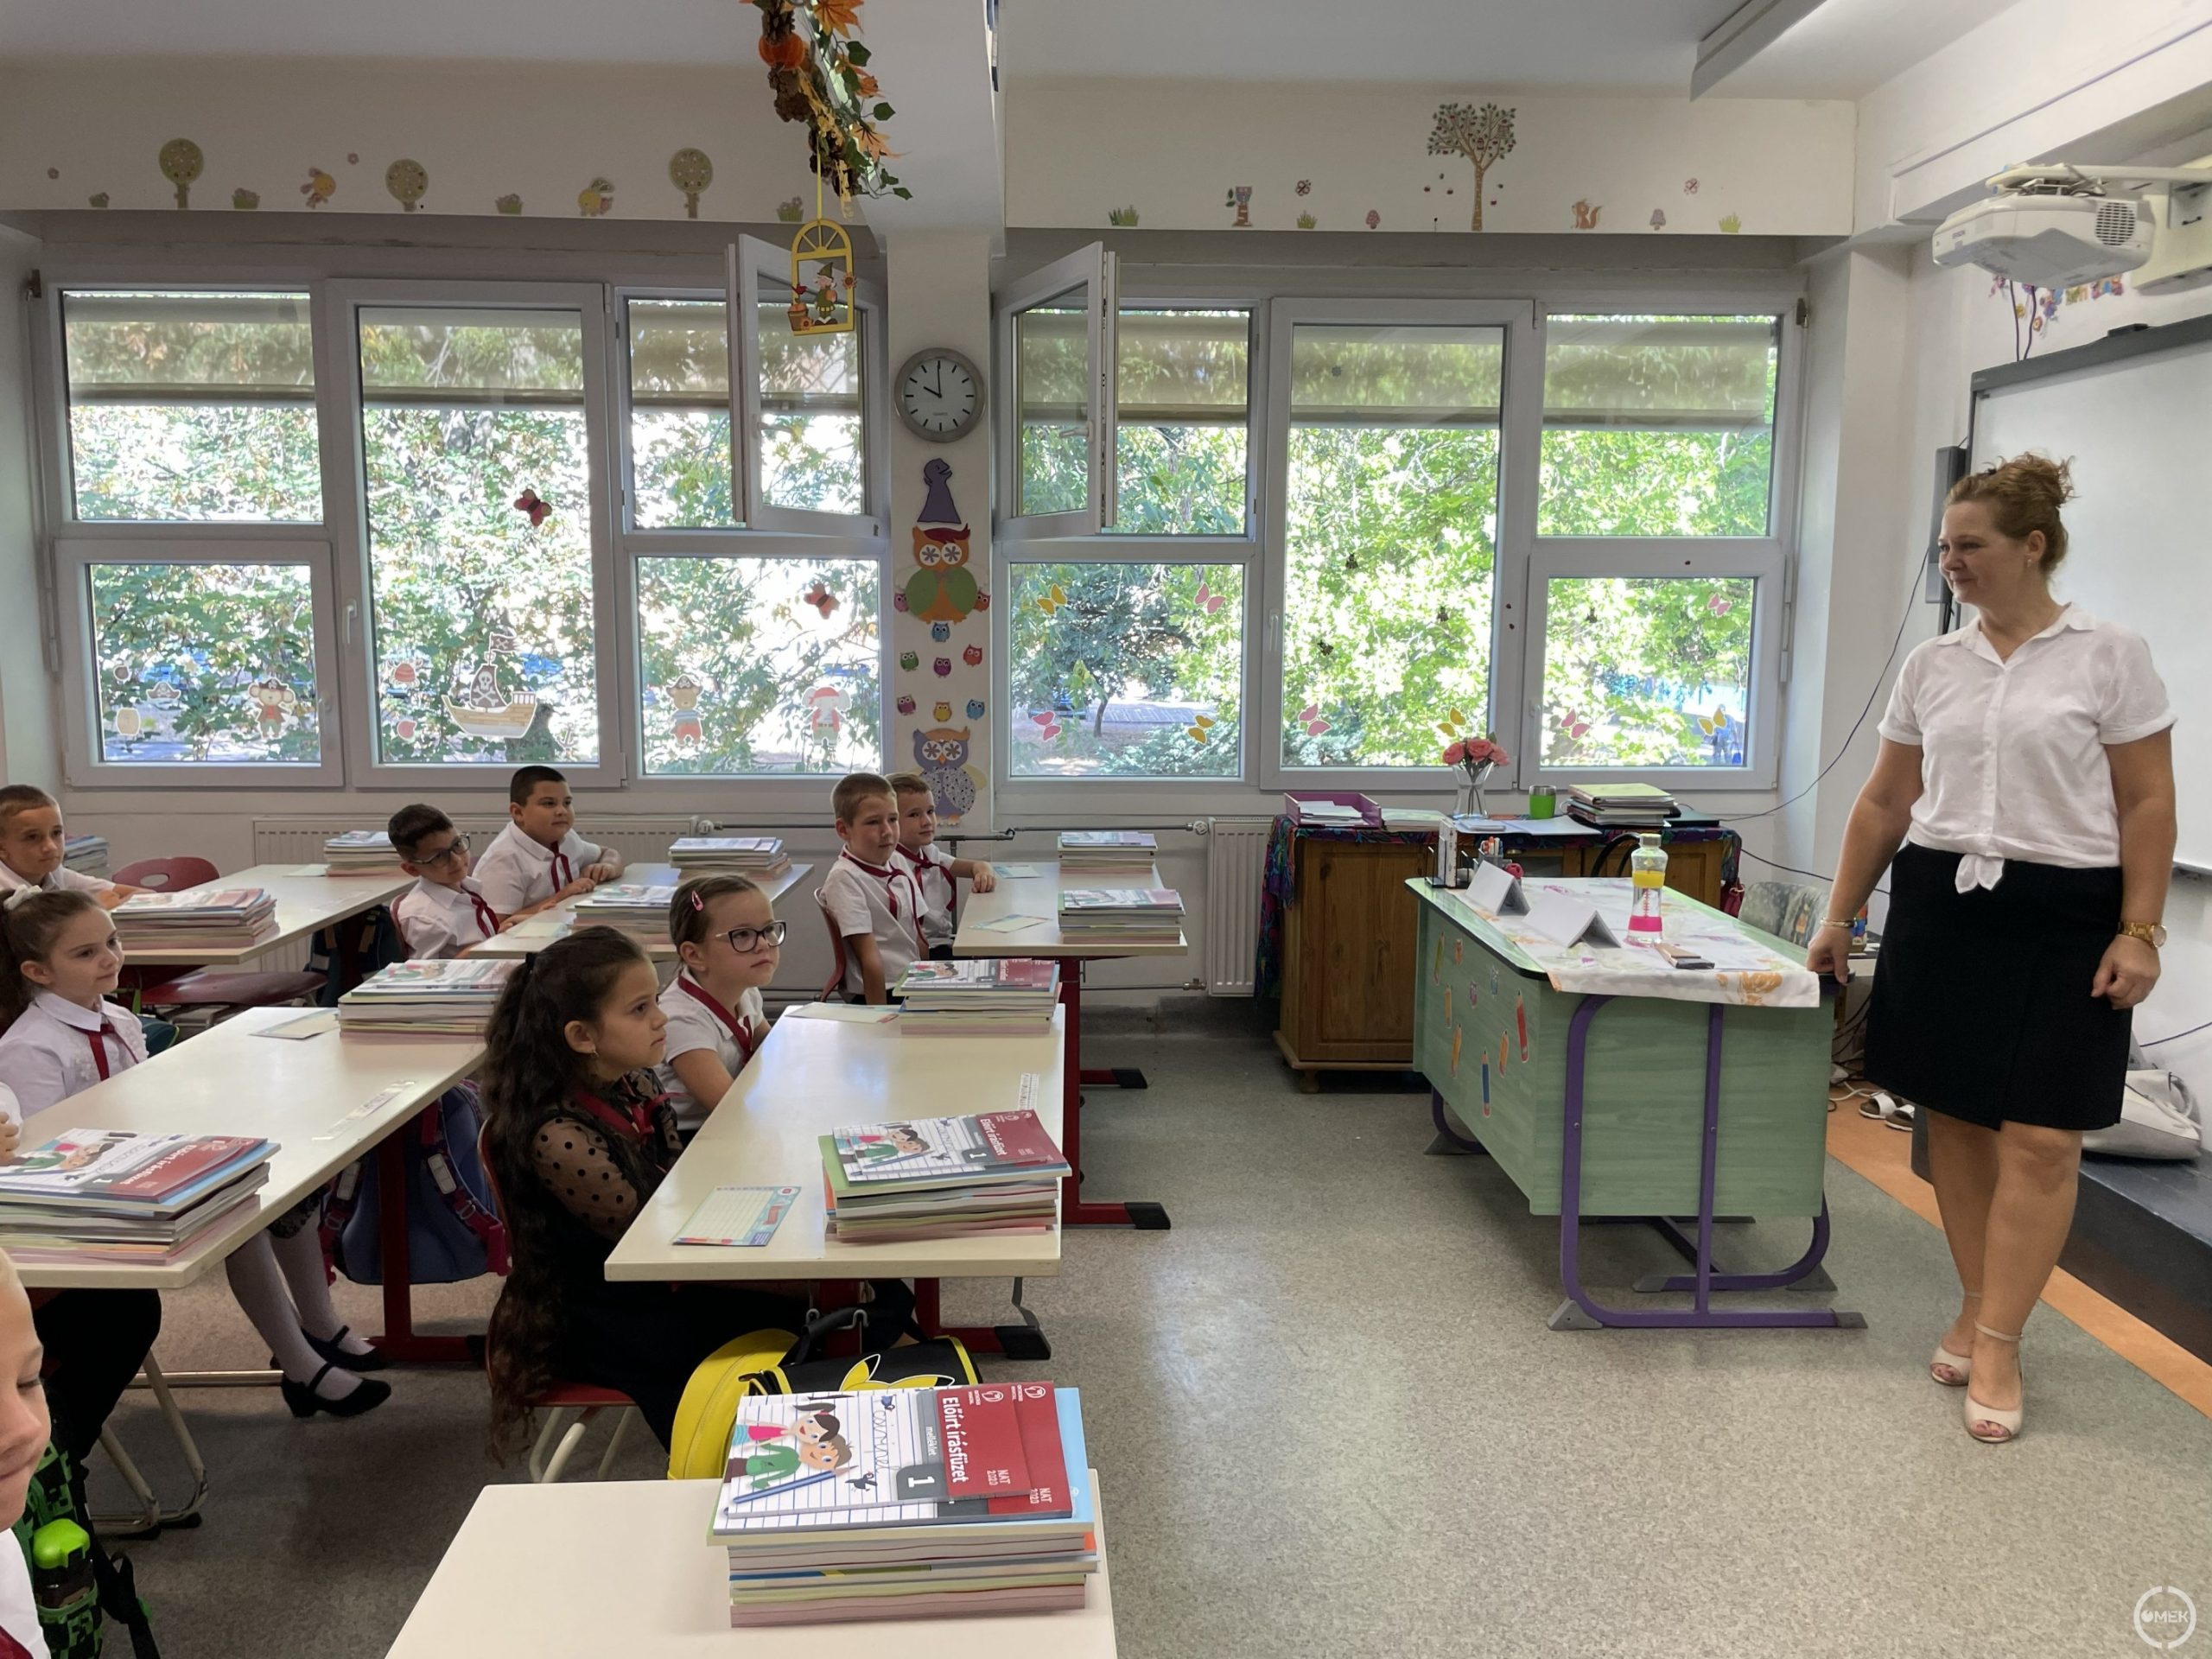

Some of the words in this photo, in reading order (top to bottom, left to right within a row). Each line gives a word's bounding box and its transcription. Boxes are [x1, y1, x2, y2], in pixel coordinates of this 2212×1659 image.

[943, 1396, 964, 1429] Előírt
[946, 1431, 969, 1484] írásfüzet
[907, 1476, 936, 1488] 1
[997, 1469, 1011, 1484] NAT
[1039, 1487, 1052, 1503] NAT
